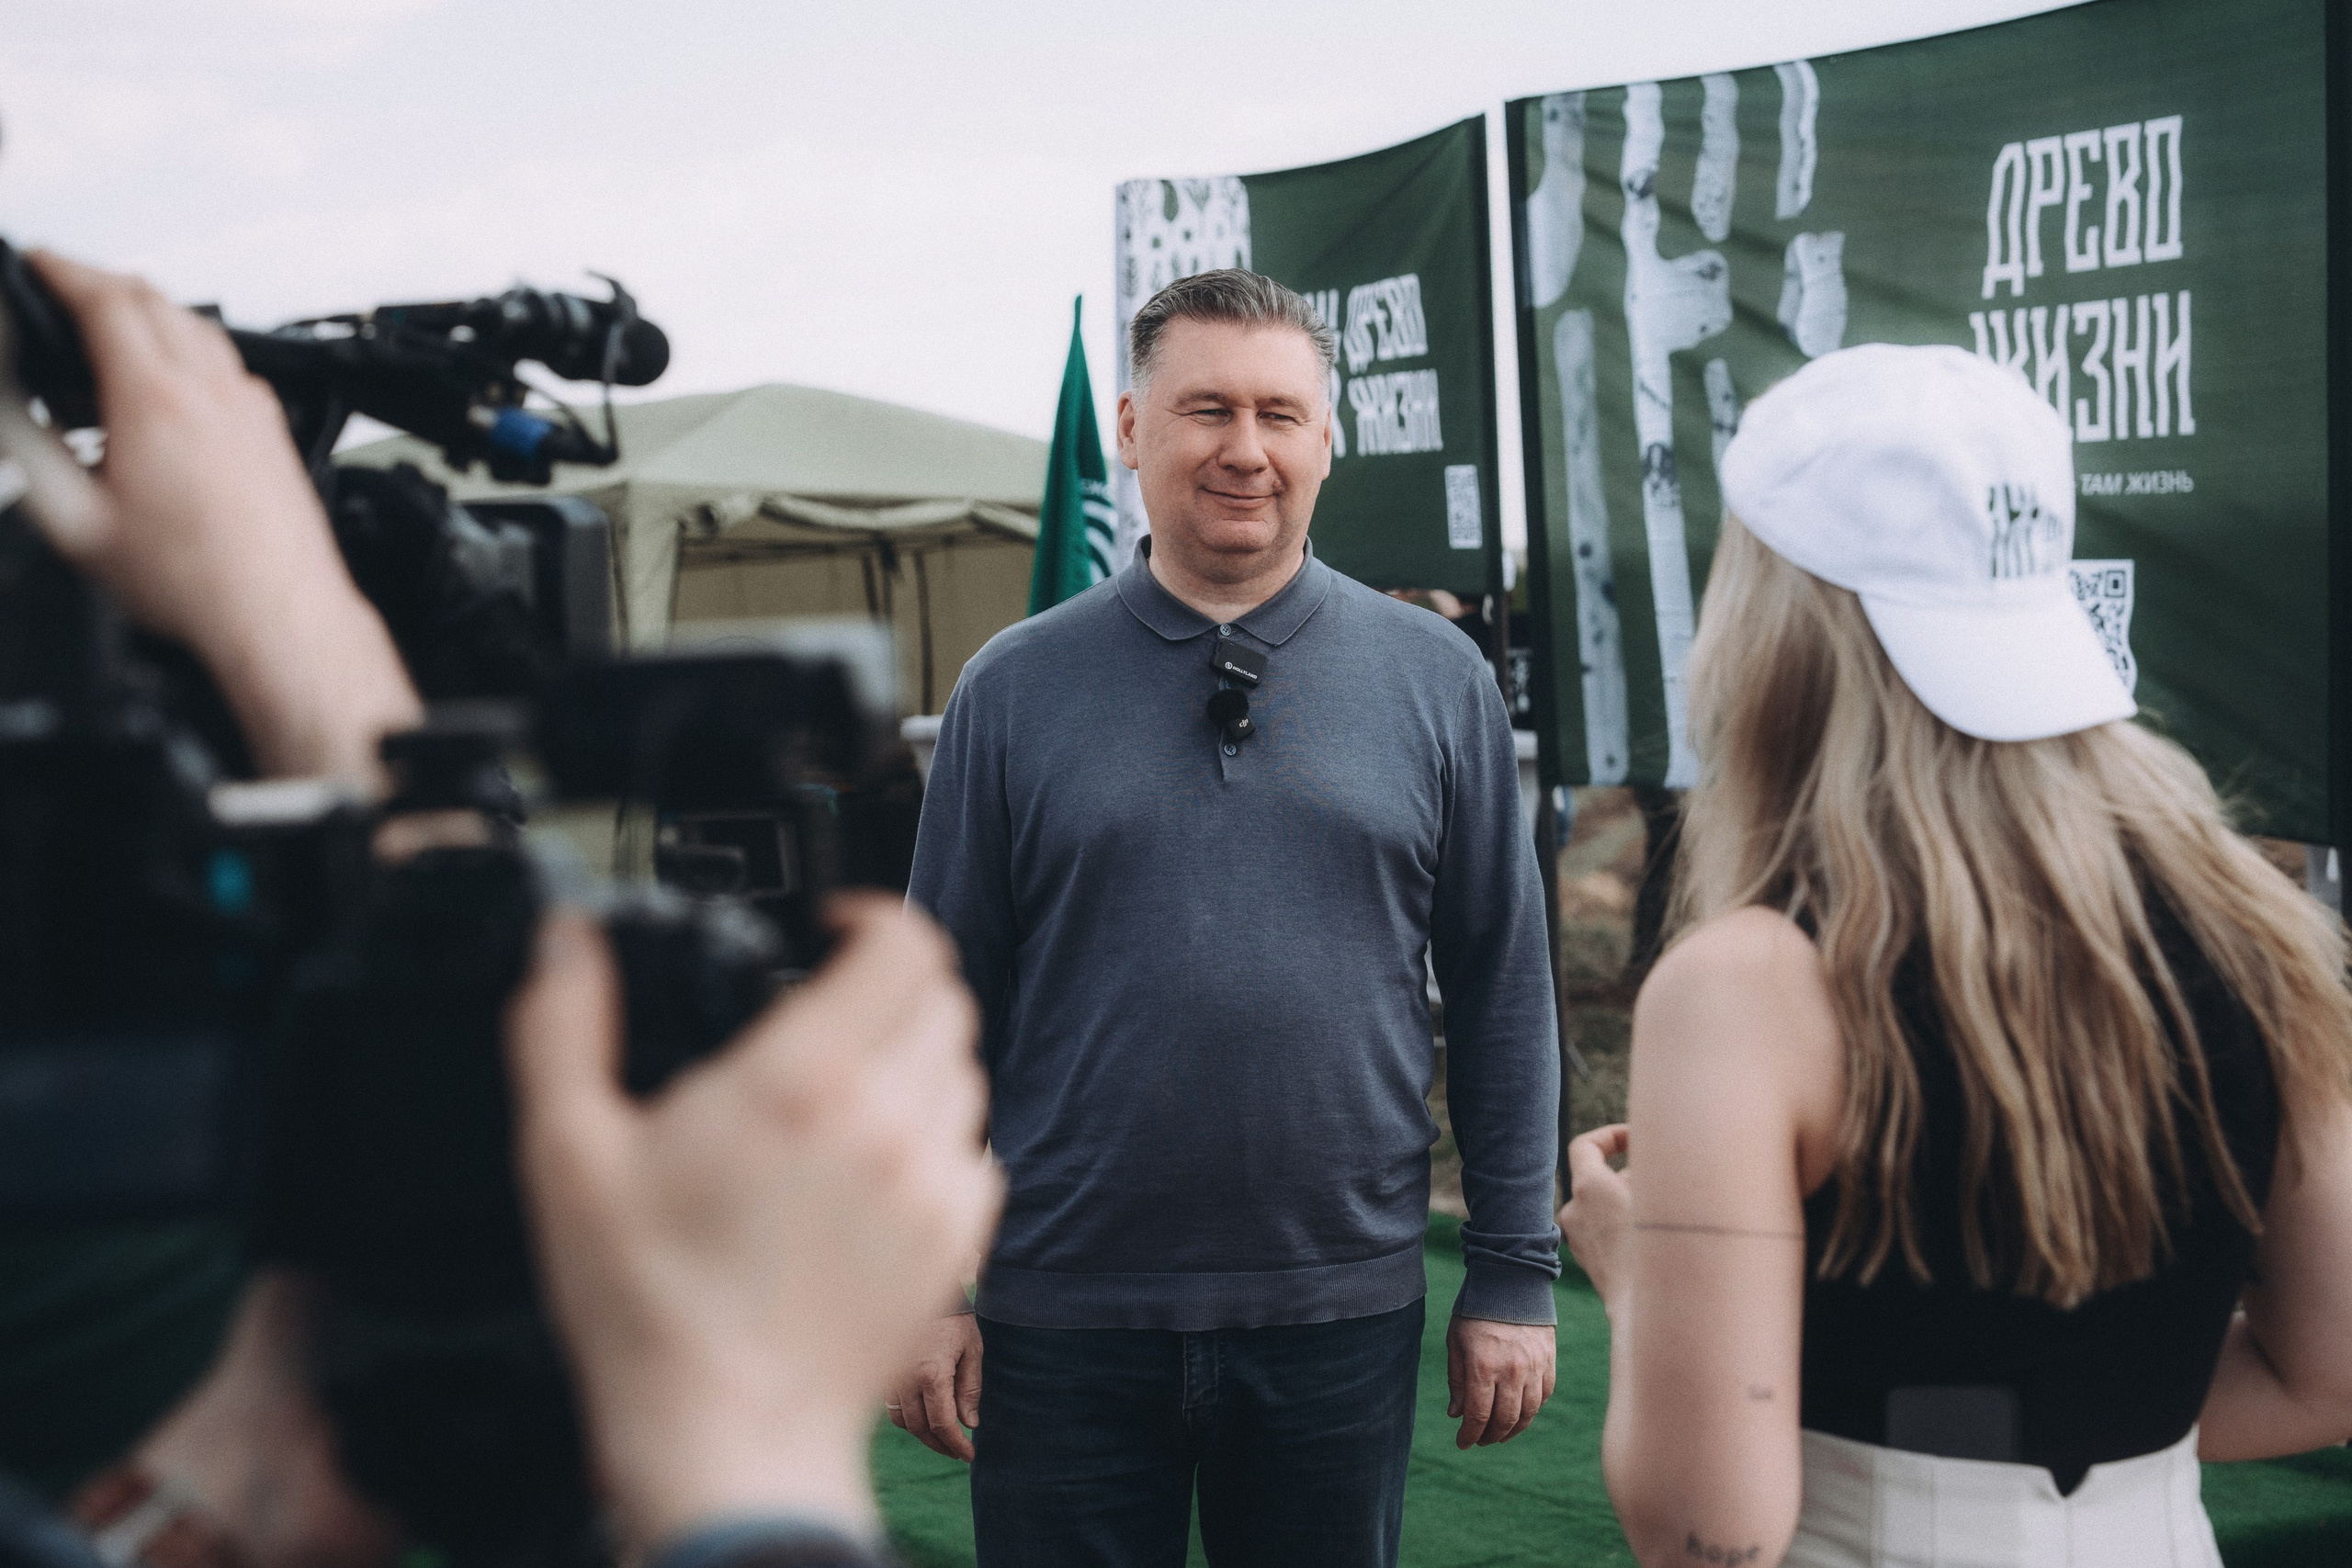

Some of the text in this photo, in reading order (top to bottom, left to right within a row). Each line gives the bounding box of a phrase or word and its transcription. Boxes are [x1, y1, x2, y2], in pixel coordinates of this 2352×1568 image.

[1982, 115, 2183, 299] ДРЕВО
[1342, 273, 1429, 376] ДРЕВО
[1347, 368, 1443, 457] ЖИЗНИ
[2080, 469, 2195, 496] ТАМ ЖИЗНЬ
[1232, 665, 1258, 680] HOLLYLAND
